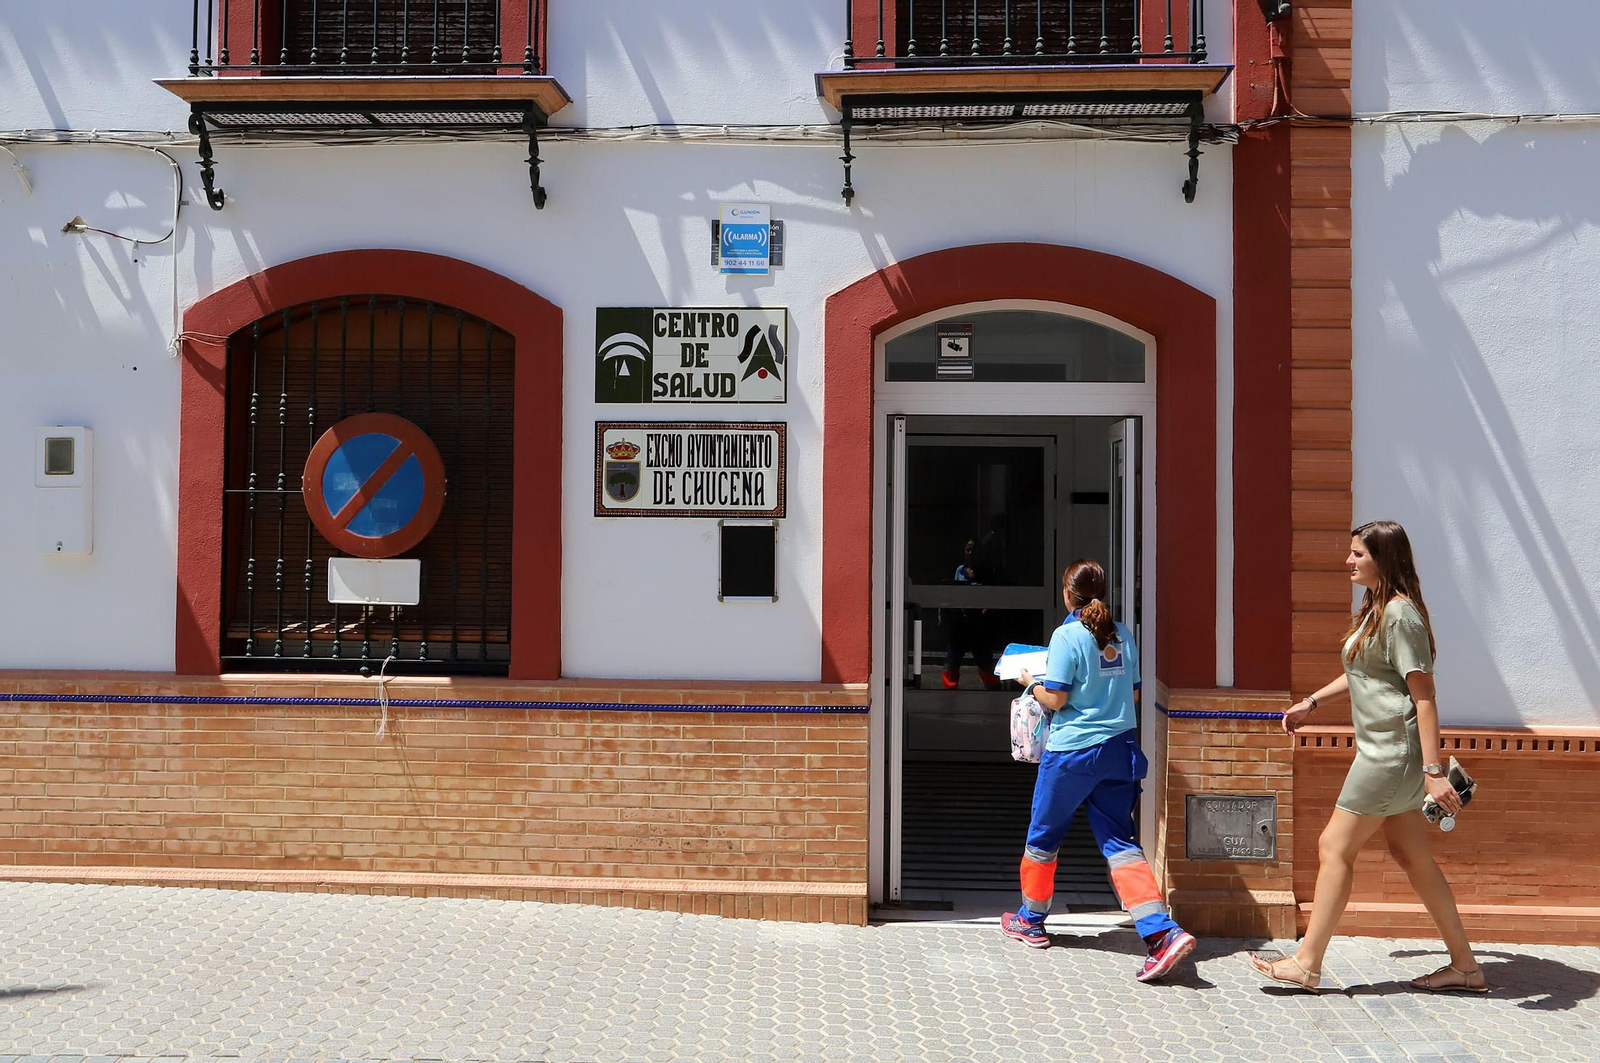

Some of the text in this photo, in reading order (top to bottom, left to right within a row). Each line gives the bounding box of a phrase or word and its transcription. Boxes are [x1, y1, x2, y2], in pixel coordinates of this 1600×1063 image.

[654, 312, 739, 338] CENTRO
[680, 343, 709, 368] DE
[653, 372, 736, 398] SALUD
[646, 433, 772, 468] EXCMO AYUNTAMIENTO
[653, 470, 765, 506] DE CHUCENA
